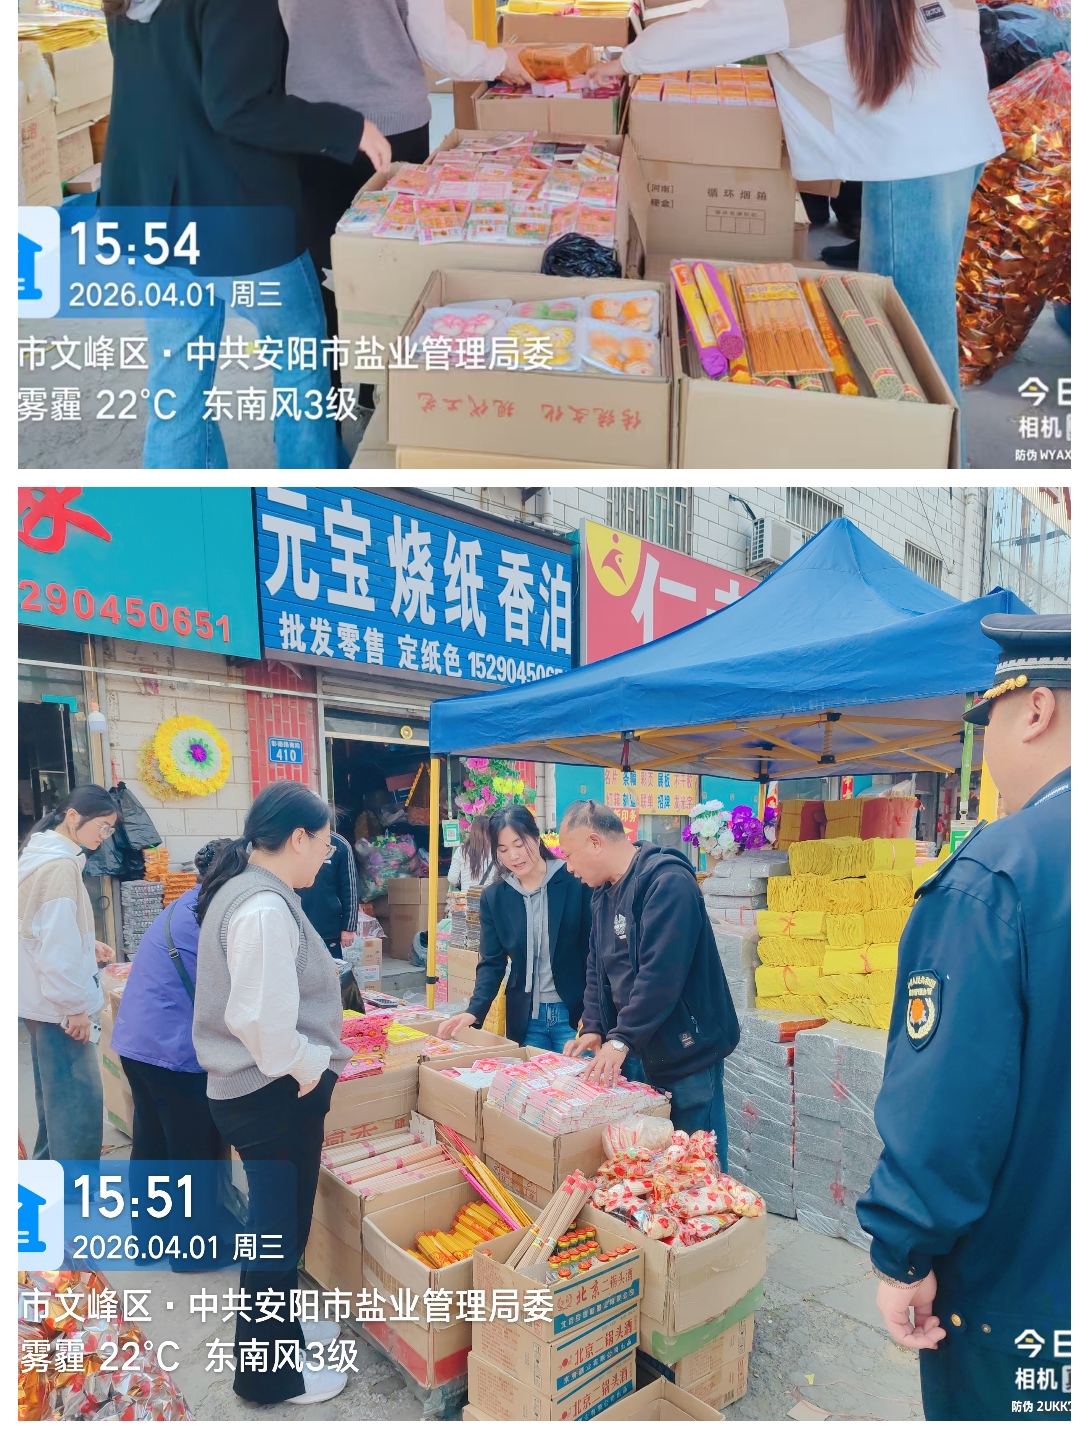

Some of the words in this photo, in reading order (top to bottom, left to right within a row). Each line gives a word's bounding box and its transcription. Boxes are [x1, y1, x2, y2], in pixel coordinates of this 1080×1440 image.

[18, 579, 231, 643] 290450651
[277, 610, 385, 665] 批发零售
[397, 633, 462, 678] 定纸色
[467, 651, 568, 684] 15290450
[275, 748, 297, 762] 410
[657, 772, 671, 789] 展板
[657, 794, 671, 810] 招牌
[574, 1317, 633, 1366] 北京二锅头酒
